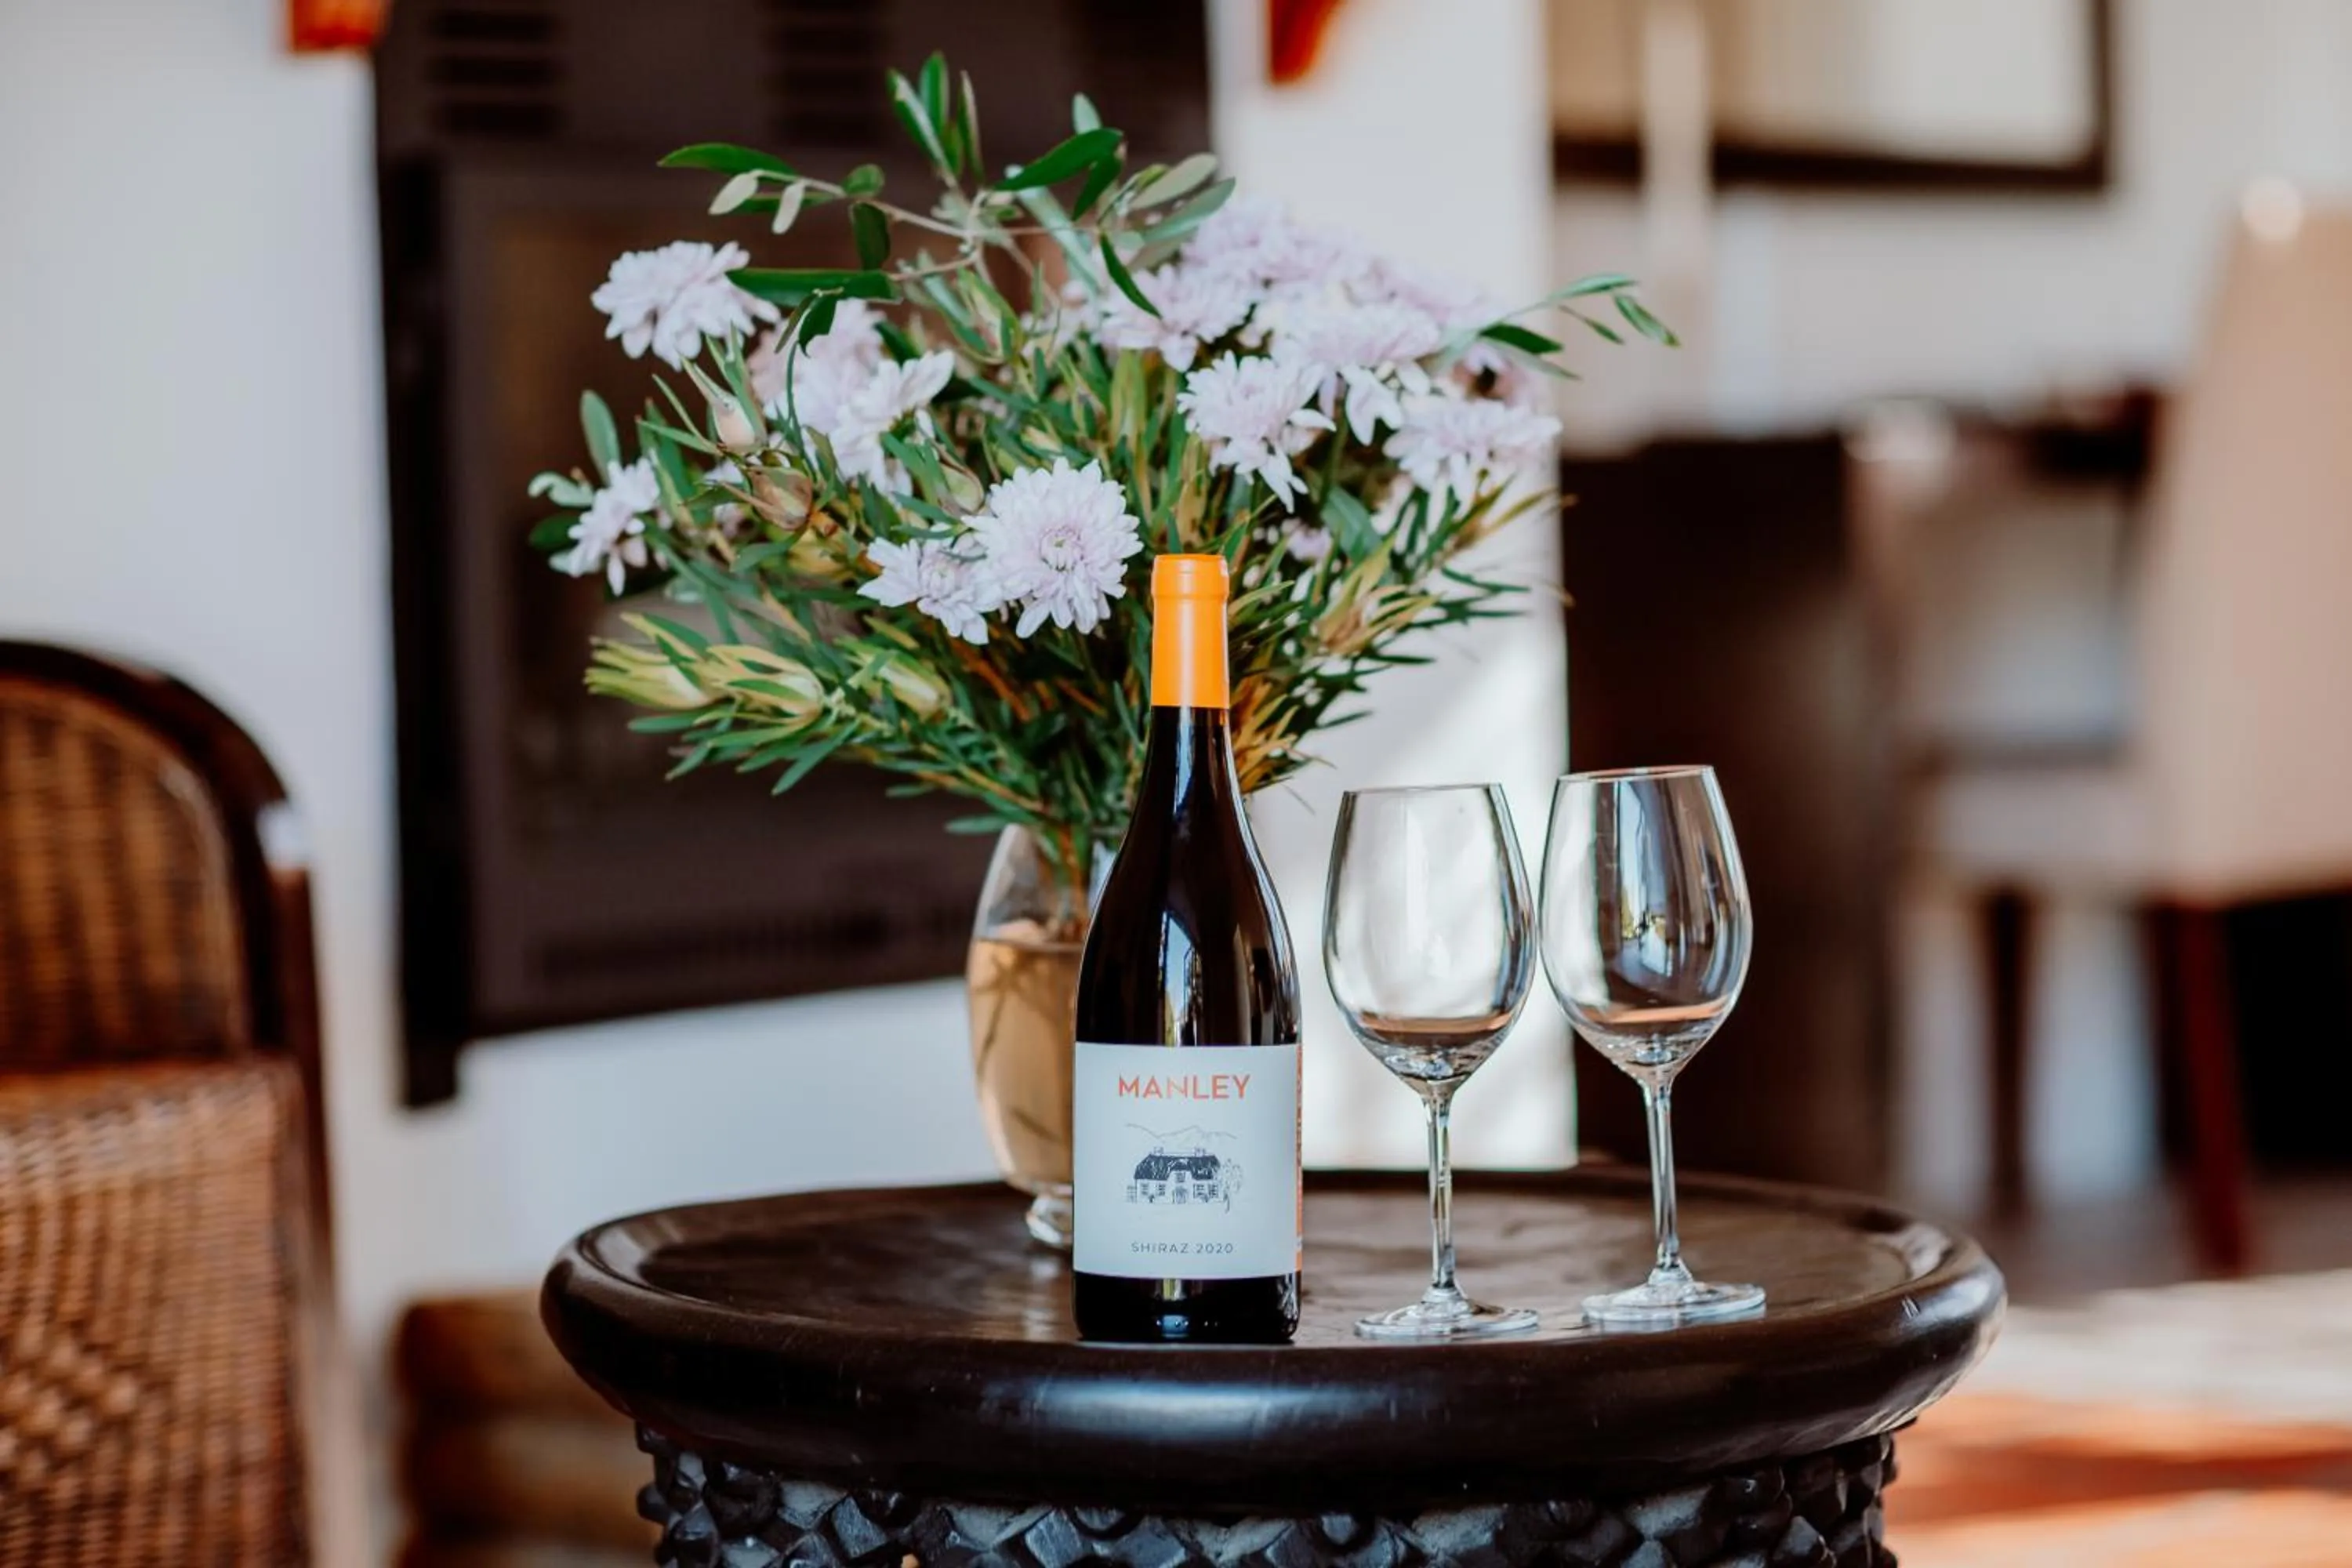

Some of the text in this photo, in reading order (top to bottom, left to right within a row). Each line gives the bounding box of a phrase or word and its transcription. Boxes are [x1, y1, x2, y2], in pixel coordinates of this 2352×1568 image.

[1118, 1075, 1251, 1099] MANLEY
[1131, 1243, 1234, 1254] SHIRAZ 2020
